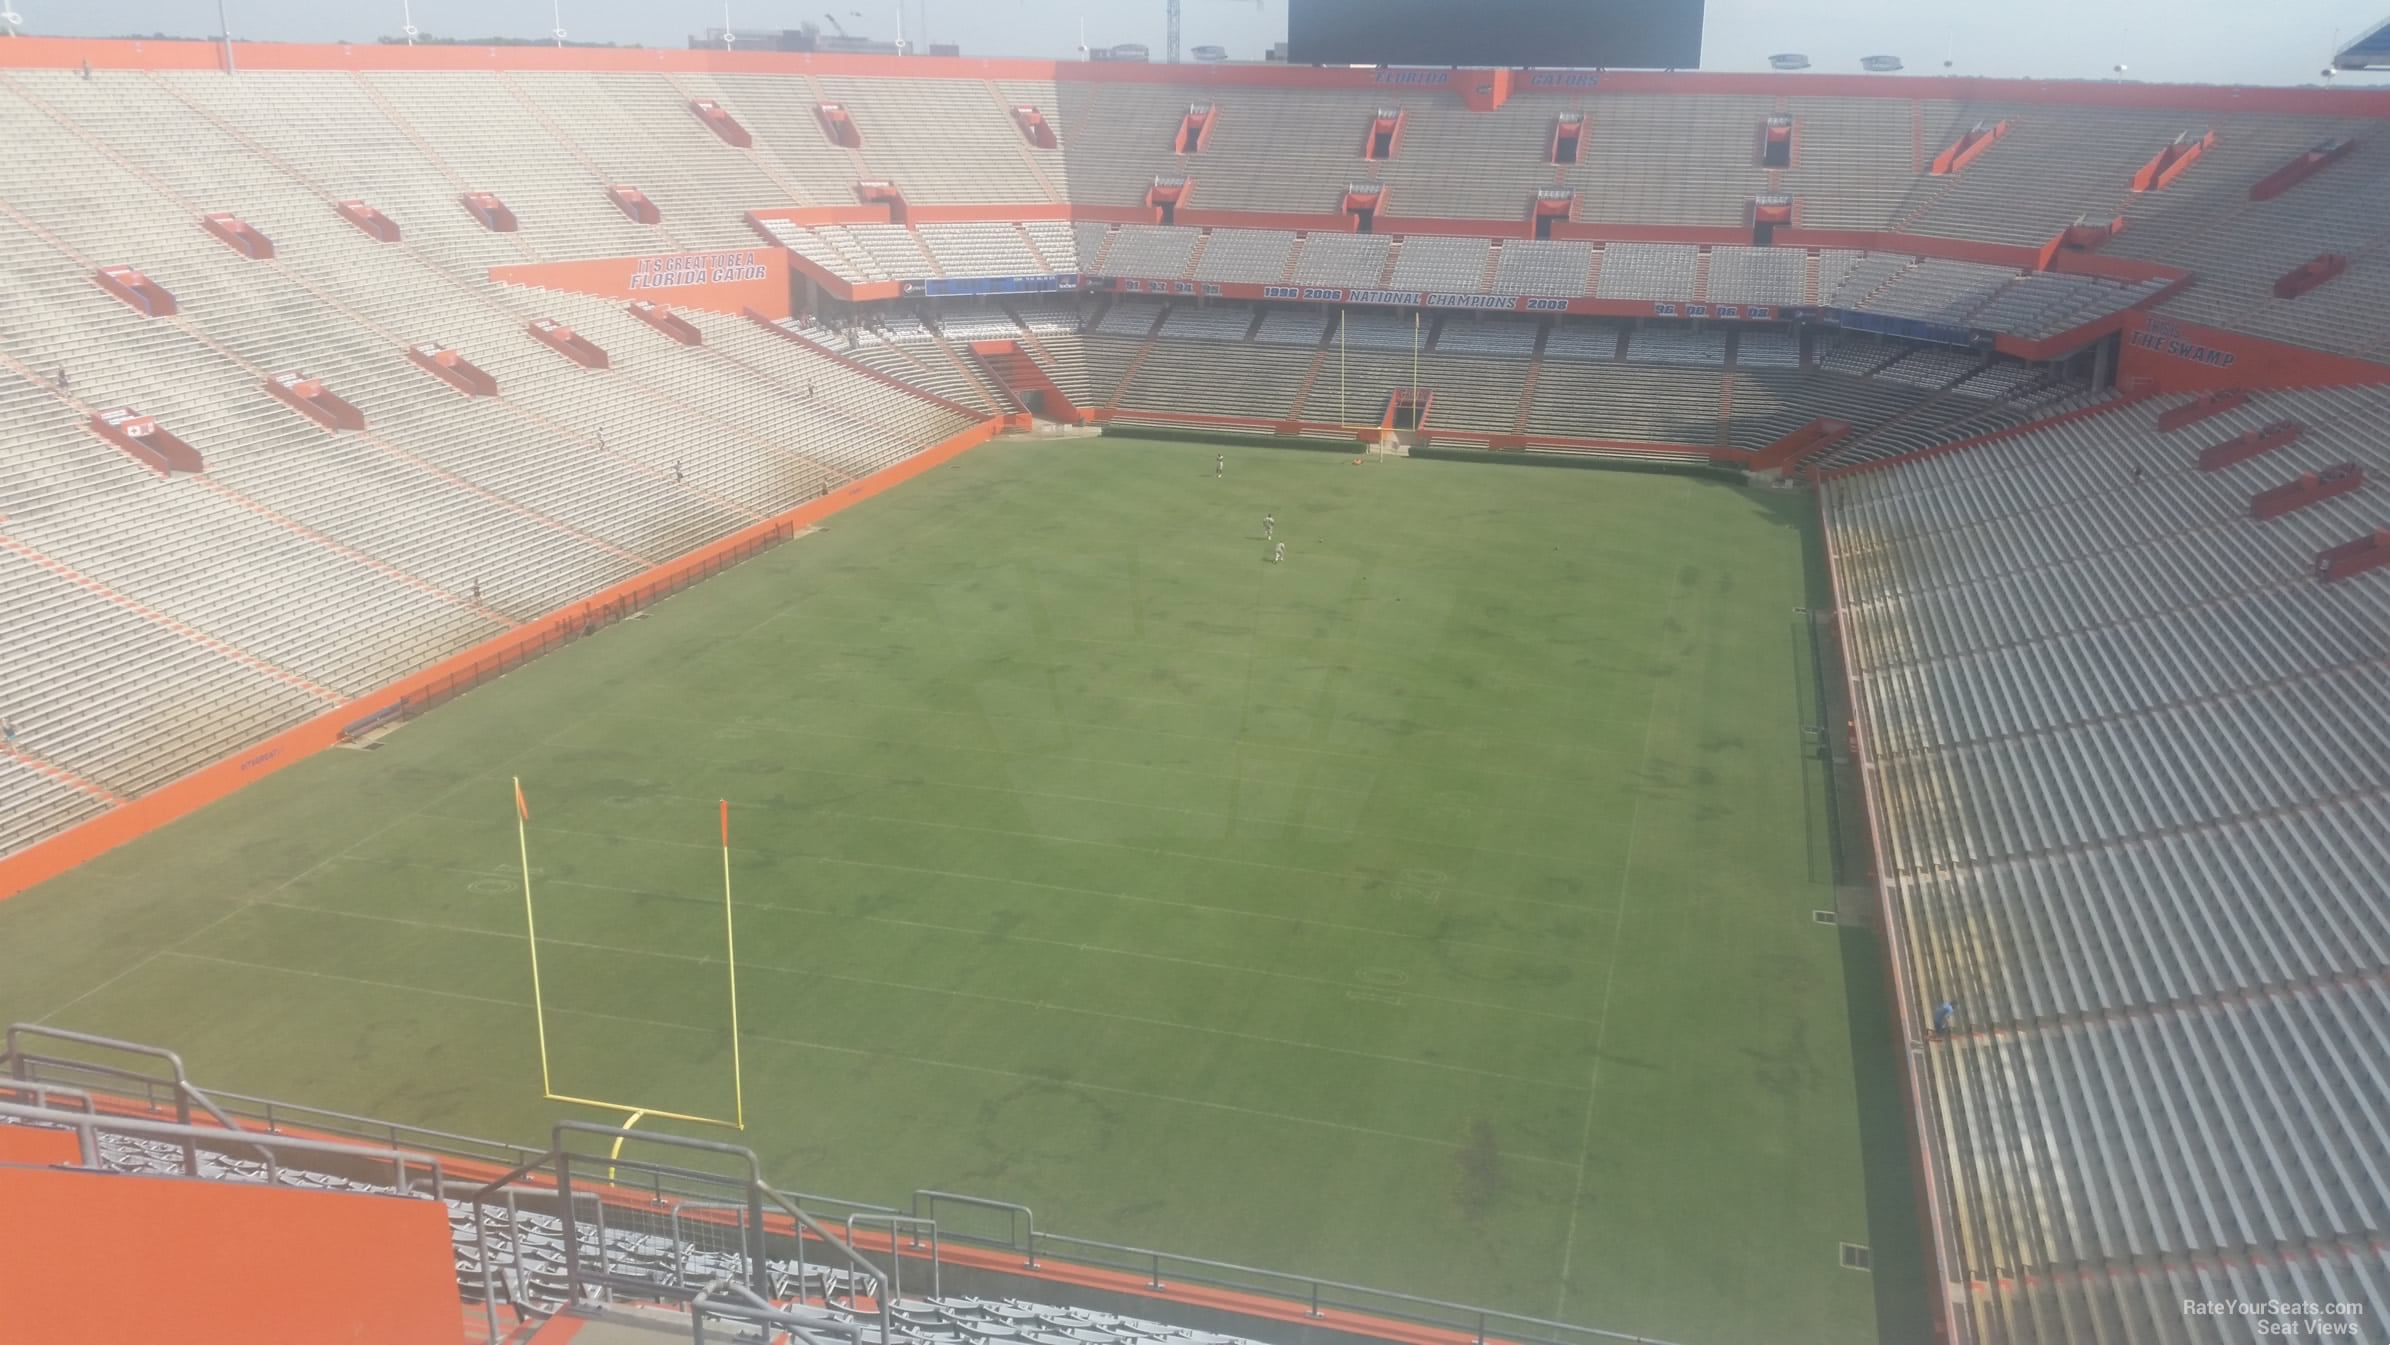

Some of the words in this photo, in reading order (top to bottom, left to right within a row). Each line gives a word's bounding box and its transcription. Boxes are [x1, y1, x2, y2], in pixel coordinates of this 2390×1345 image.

[1376, 71, 1449, 84] FLORIDA
[1531, 73, 1601, 87] GATORS
[665, 255, 708, 272] GREAT
[710, 254, 725, 268] TO
[727, 253, 742, 267] BE
[745, 252, 755, 266] A
[629, 268, 707, 289] FLORIDA
[712, 265, 766, 283] GATOR
[1264, 286, 1299, 298] 1996
[1303, 289, 1342, 301] 2006
[1347, 290, 1420, 306] NATIONAL
[1426, 293, 1517, 309] CHAMPIONS
[1526, 299, 1568, 311] 2008
[2129, 330, 2165, 352] THE
[2168, 339, 2236, 369] SWAMP
